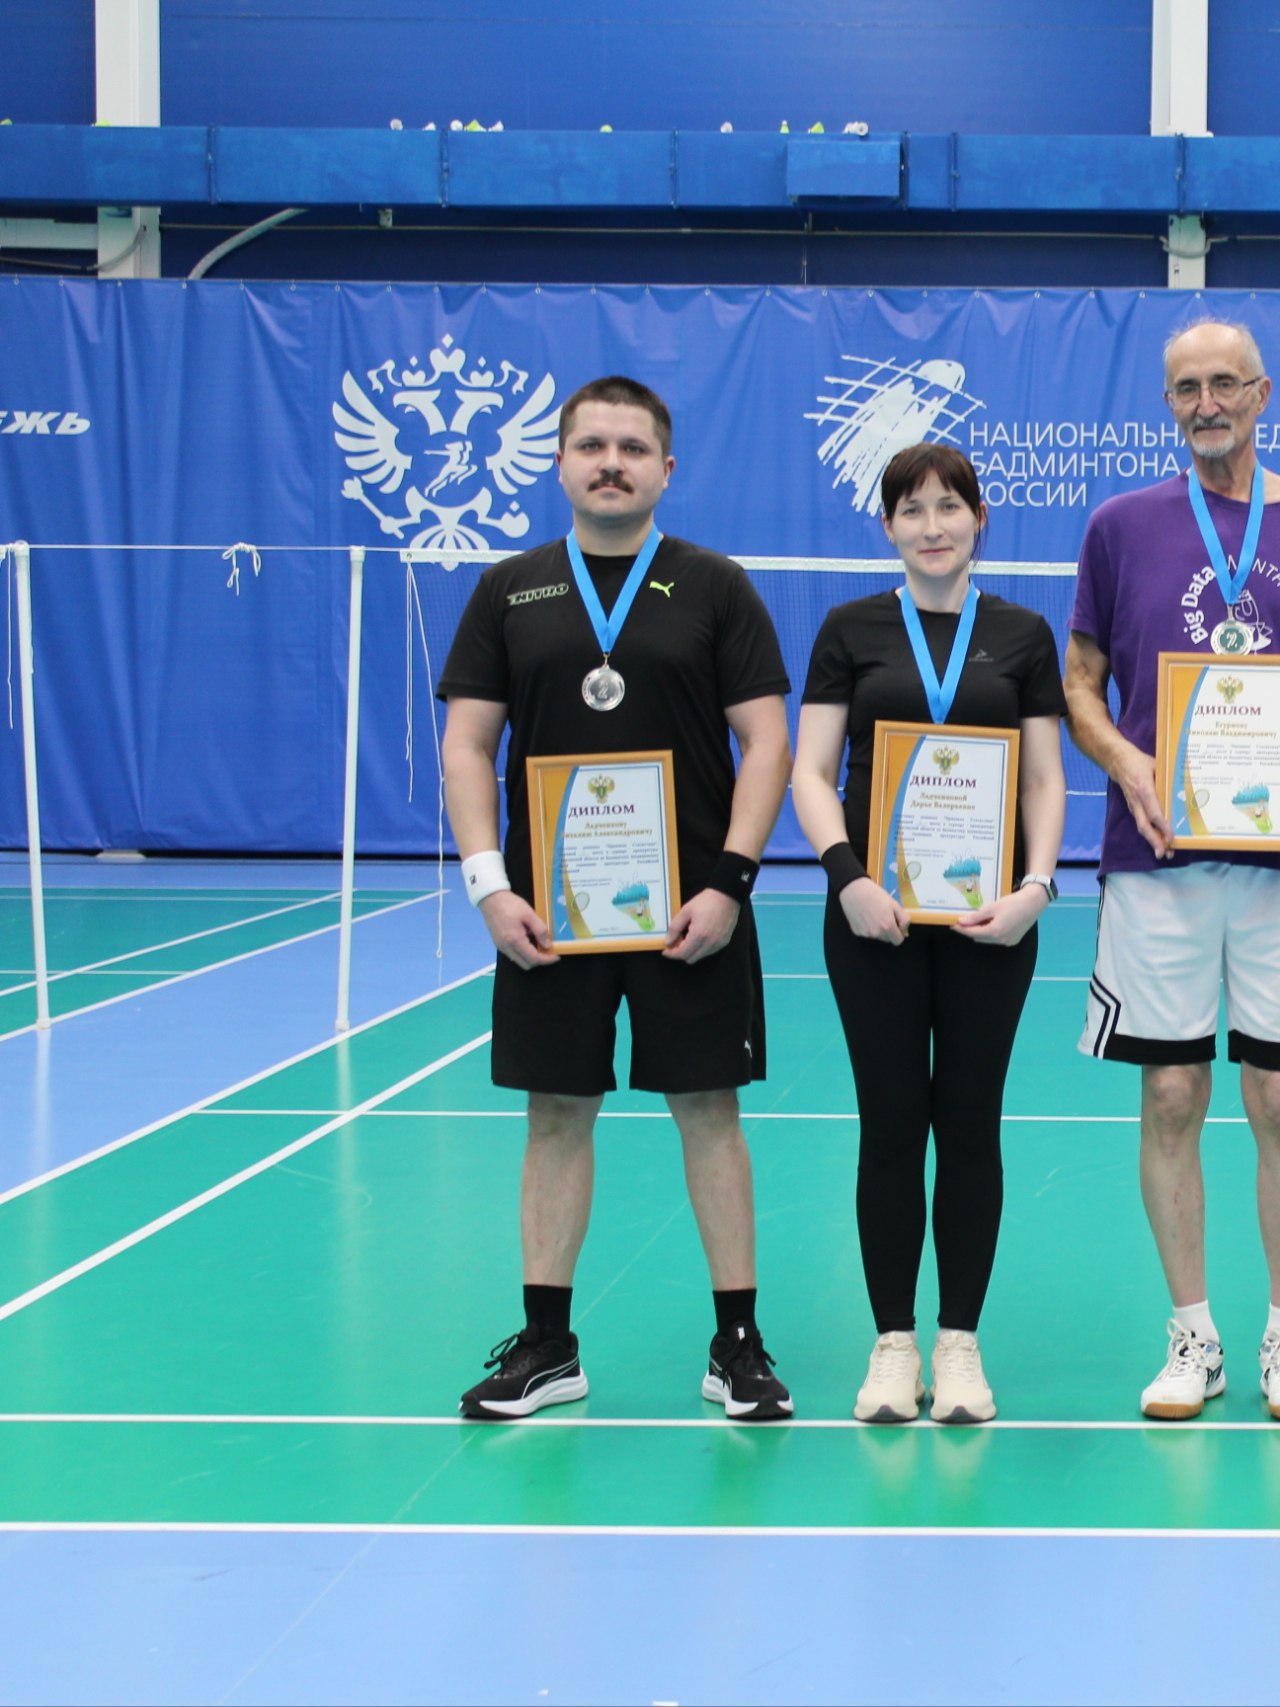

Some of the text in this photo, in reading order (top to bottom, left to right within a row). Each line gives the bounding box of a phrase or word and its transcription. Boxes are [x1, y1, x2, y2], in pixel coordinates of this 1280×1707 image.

[970, 422, 1185, 451] НАЦИОНАЛЬН
[969, 451, 1181, 481] БАДМИНТОНА
[1181, 565, 1217, 608] Data
[1184, 610, 1209, 645] Big
[1195, 705, 1261, 716] ДИПЛОМ
[909, 775, 977, 788] ДИПЛОМ
[568, 804, 635, 818] ДИПЛОМ
